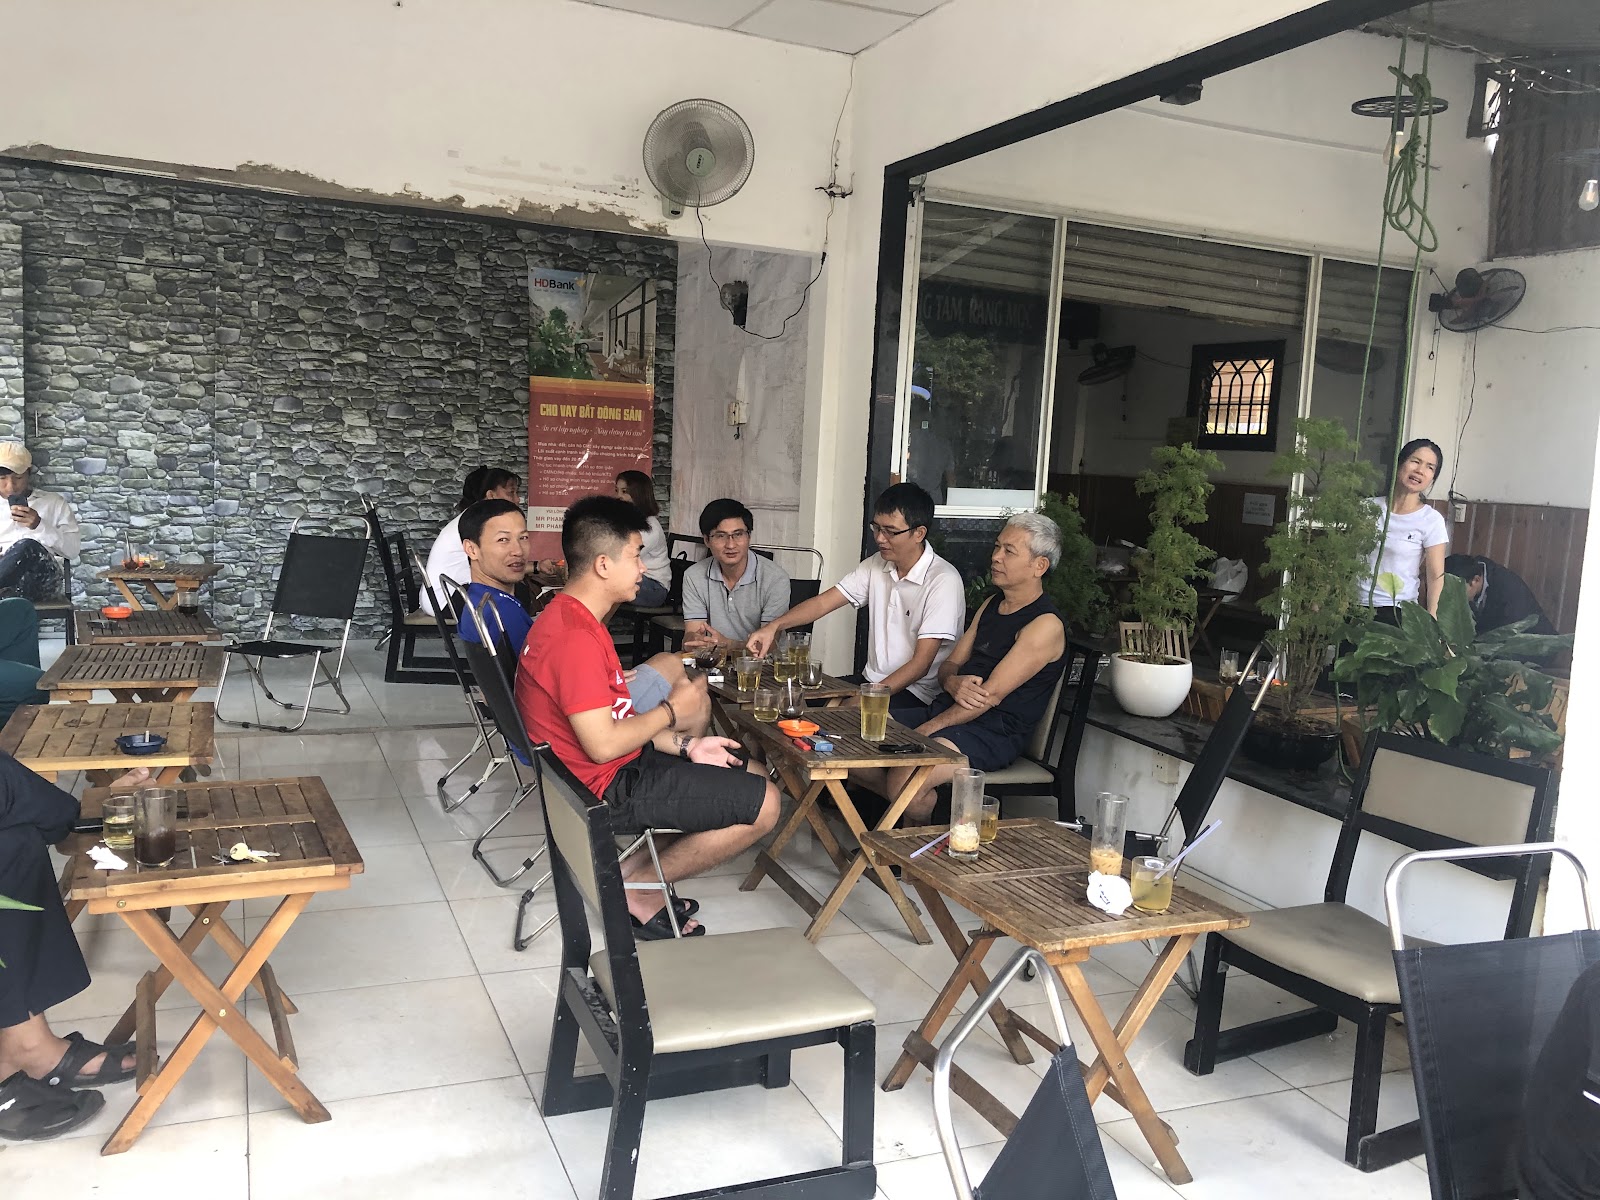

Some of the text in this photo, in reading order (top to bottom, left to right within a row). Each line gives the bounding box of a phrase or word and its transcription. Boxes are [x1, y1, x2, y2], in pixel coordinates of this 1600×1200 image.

[534, 278, 575, 290] HDBank
[540, 403, 642, 422] CHO VAY BẤT ĐỘNG SẢN
